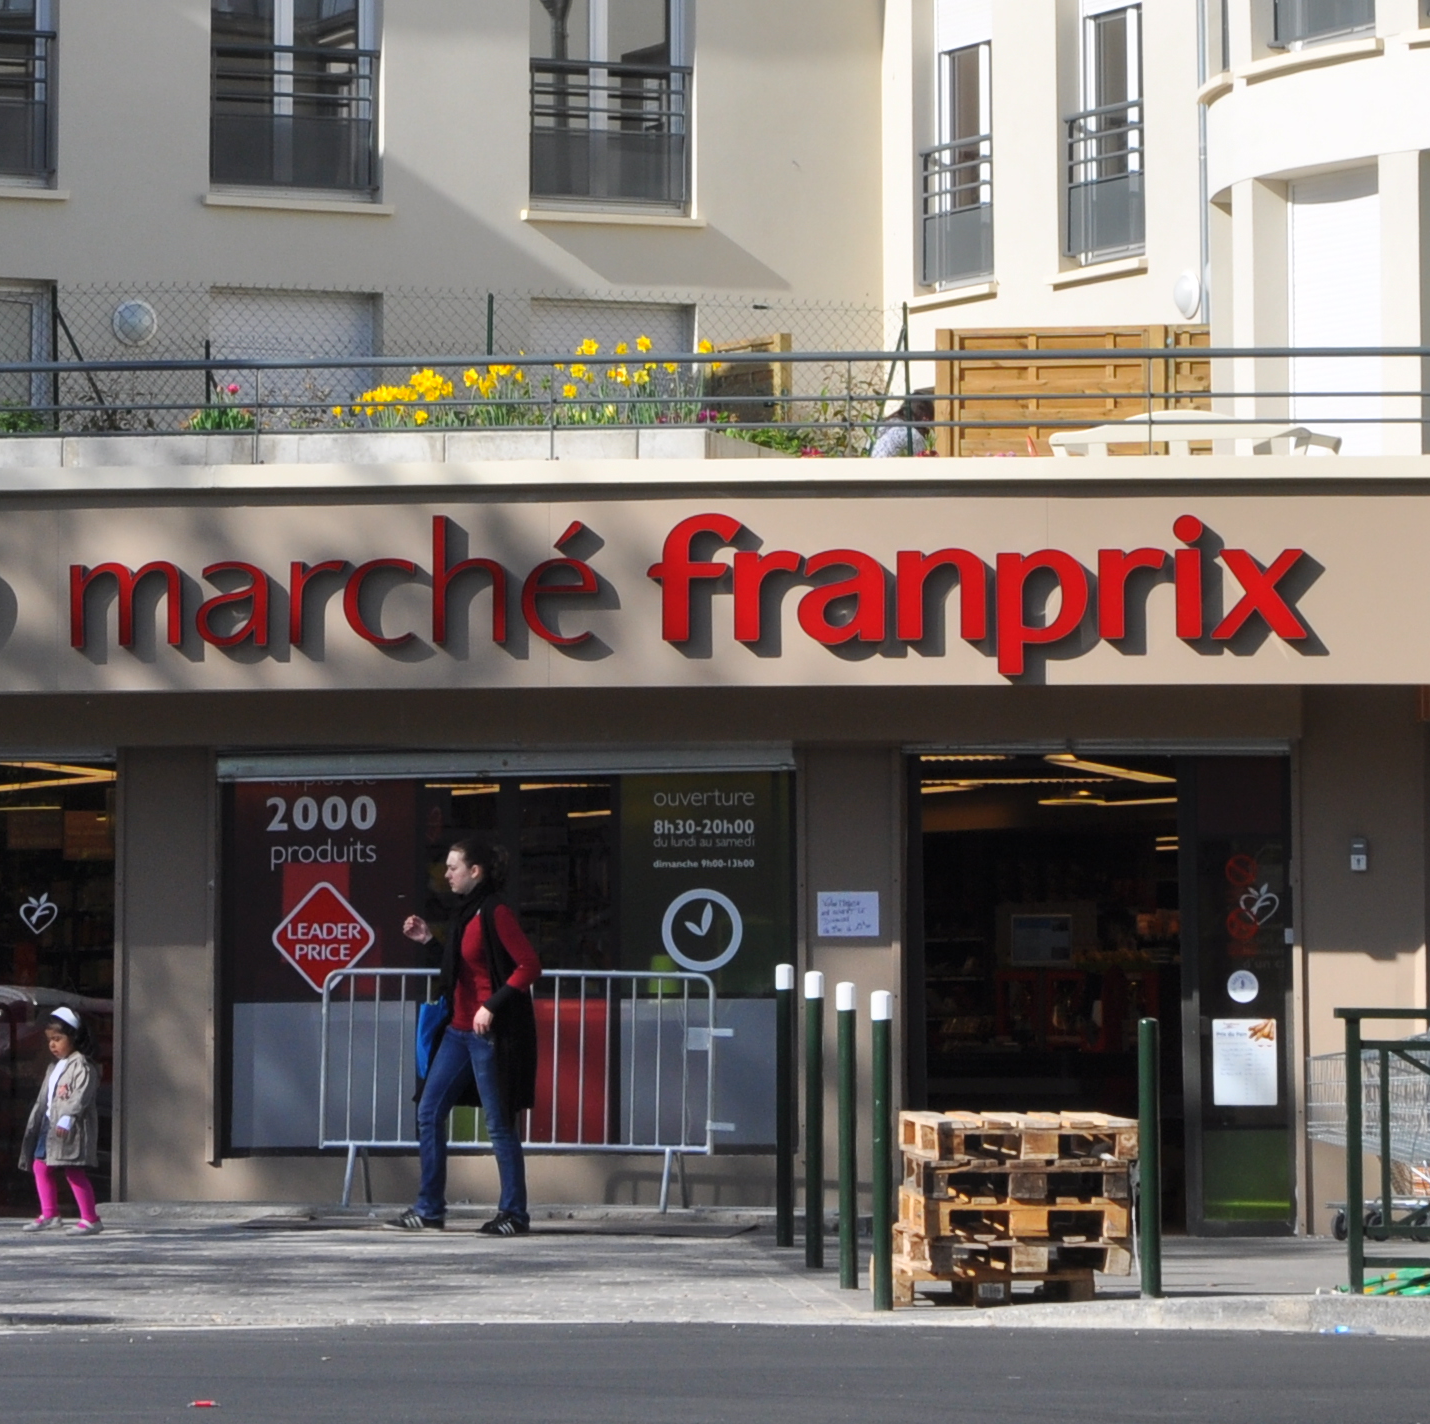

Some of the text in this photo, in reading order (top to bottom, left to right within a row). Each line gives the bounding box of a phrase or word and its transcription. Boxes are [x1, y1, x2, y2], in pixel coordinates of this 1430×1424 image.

[69, 512, 1309, 676] marché franprix
[653, 788, 755, 807] ouverture
[265, 795, 377, 832] 2000
[653, 819, 755, 835] 8h30-20h00
[653, 835, 755, 847] du lundi au samedi
[270, 837, 377, 871] produits
[652, 858, 755, 869] dimanche 9h00-13h00
[286, 922, 362, 940] LEADER
[294, 943, 352, 961] PRICE
